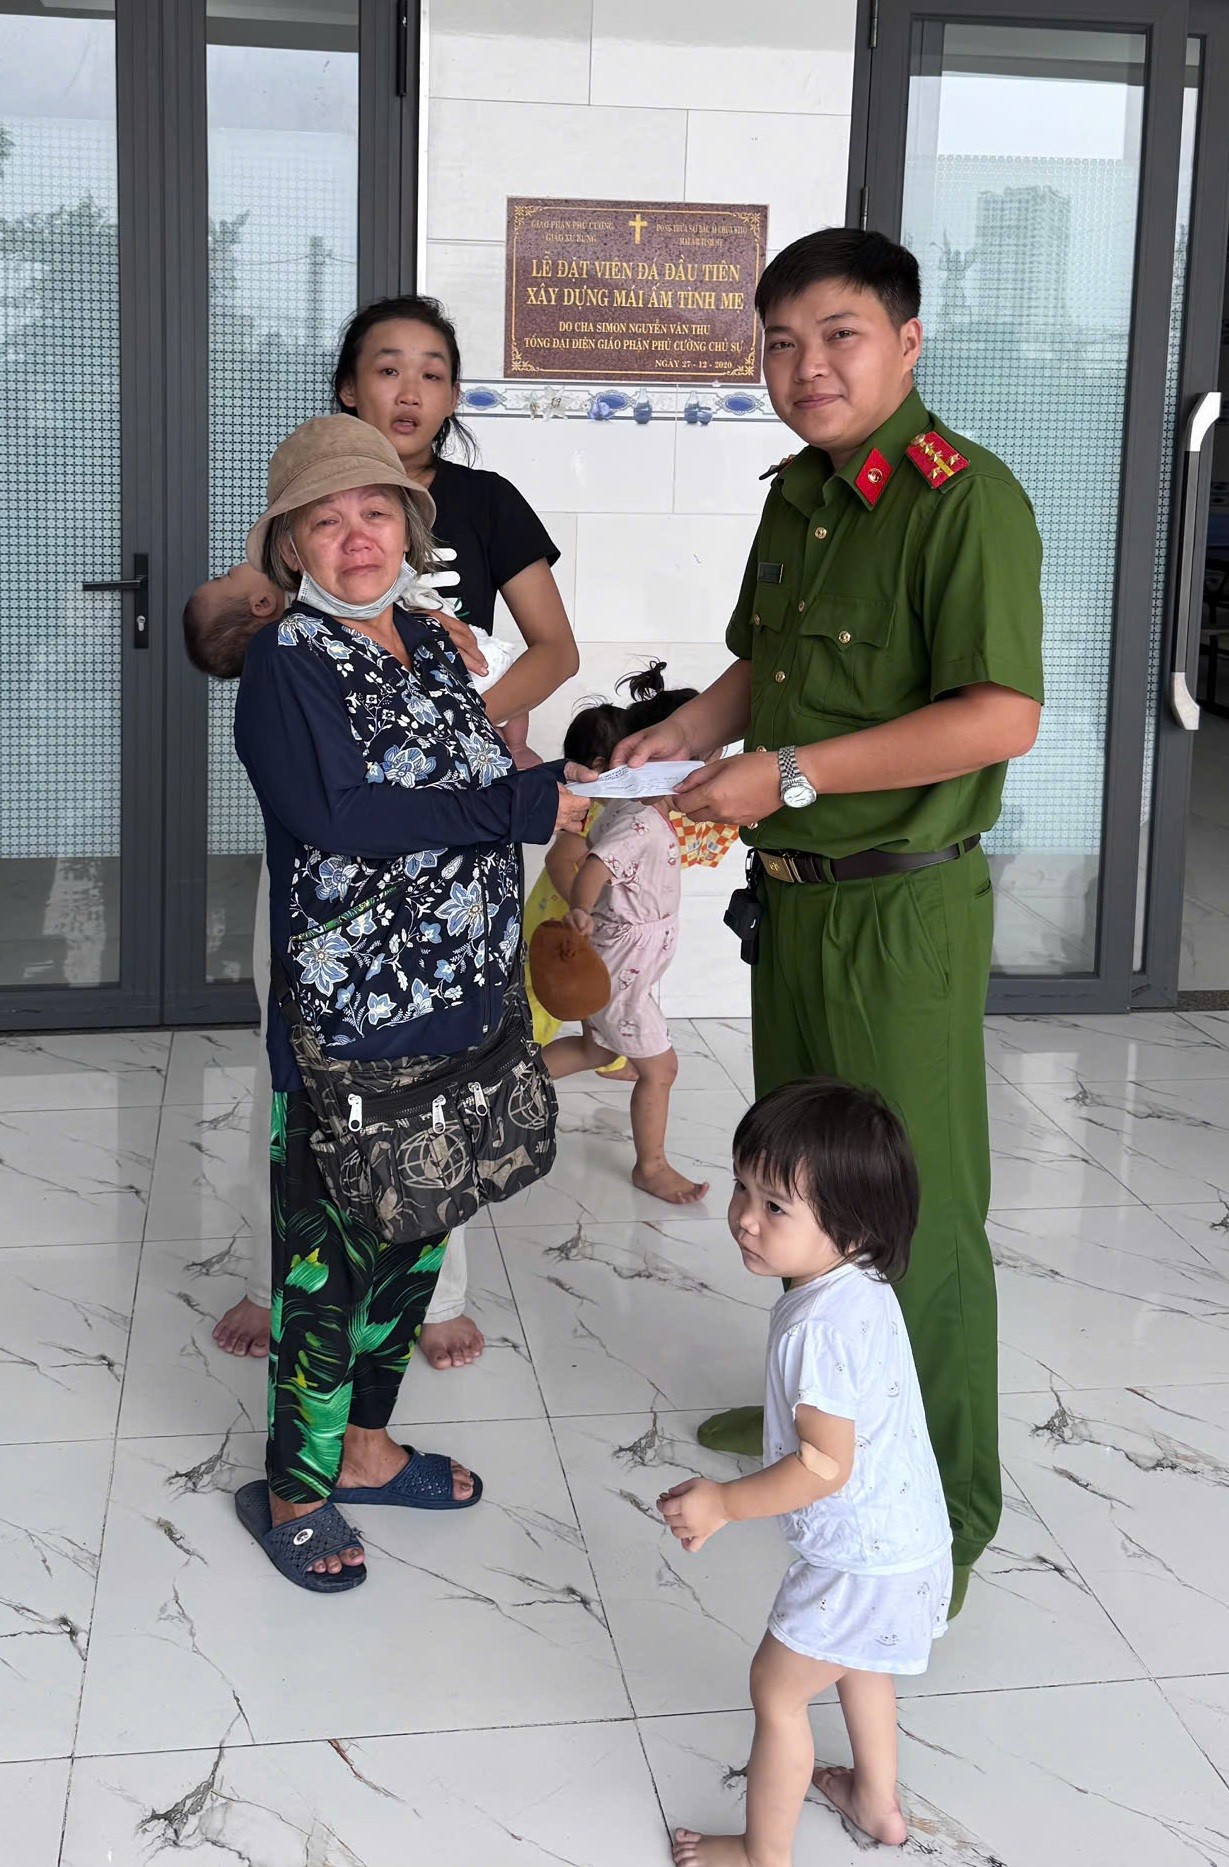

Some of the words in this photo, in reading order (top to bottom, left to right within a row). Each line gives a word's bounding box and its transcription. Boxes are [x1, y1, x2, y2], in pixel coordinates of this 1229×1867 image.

[531, 250, 552, 277] LỄ
[557, 256, 590, 282] ĐẶT
[594, 257, 633, 280] VIÊN
[637, 257, 660, 280] ĐÁ
[664, 254, 698, 281] ĐẦU
[702, 260, 741, 282] TIÊN
[526, 282, 560, 305] XÂY
[563, 284, 609, 310] DỰNG
[613, 285, 645, 308] MÁI
[648, 282, 674, 308] ẤM
[677, 286, 717, 309] TÌNH
[720, 292, 744, 314] MẸ
[559, 321, 573, 333] DO
[574, 322, 594, 333] CHA
[596, 322, 627, 334] SIMON
[597, 337, 621, 350] GIÁO
